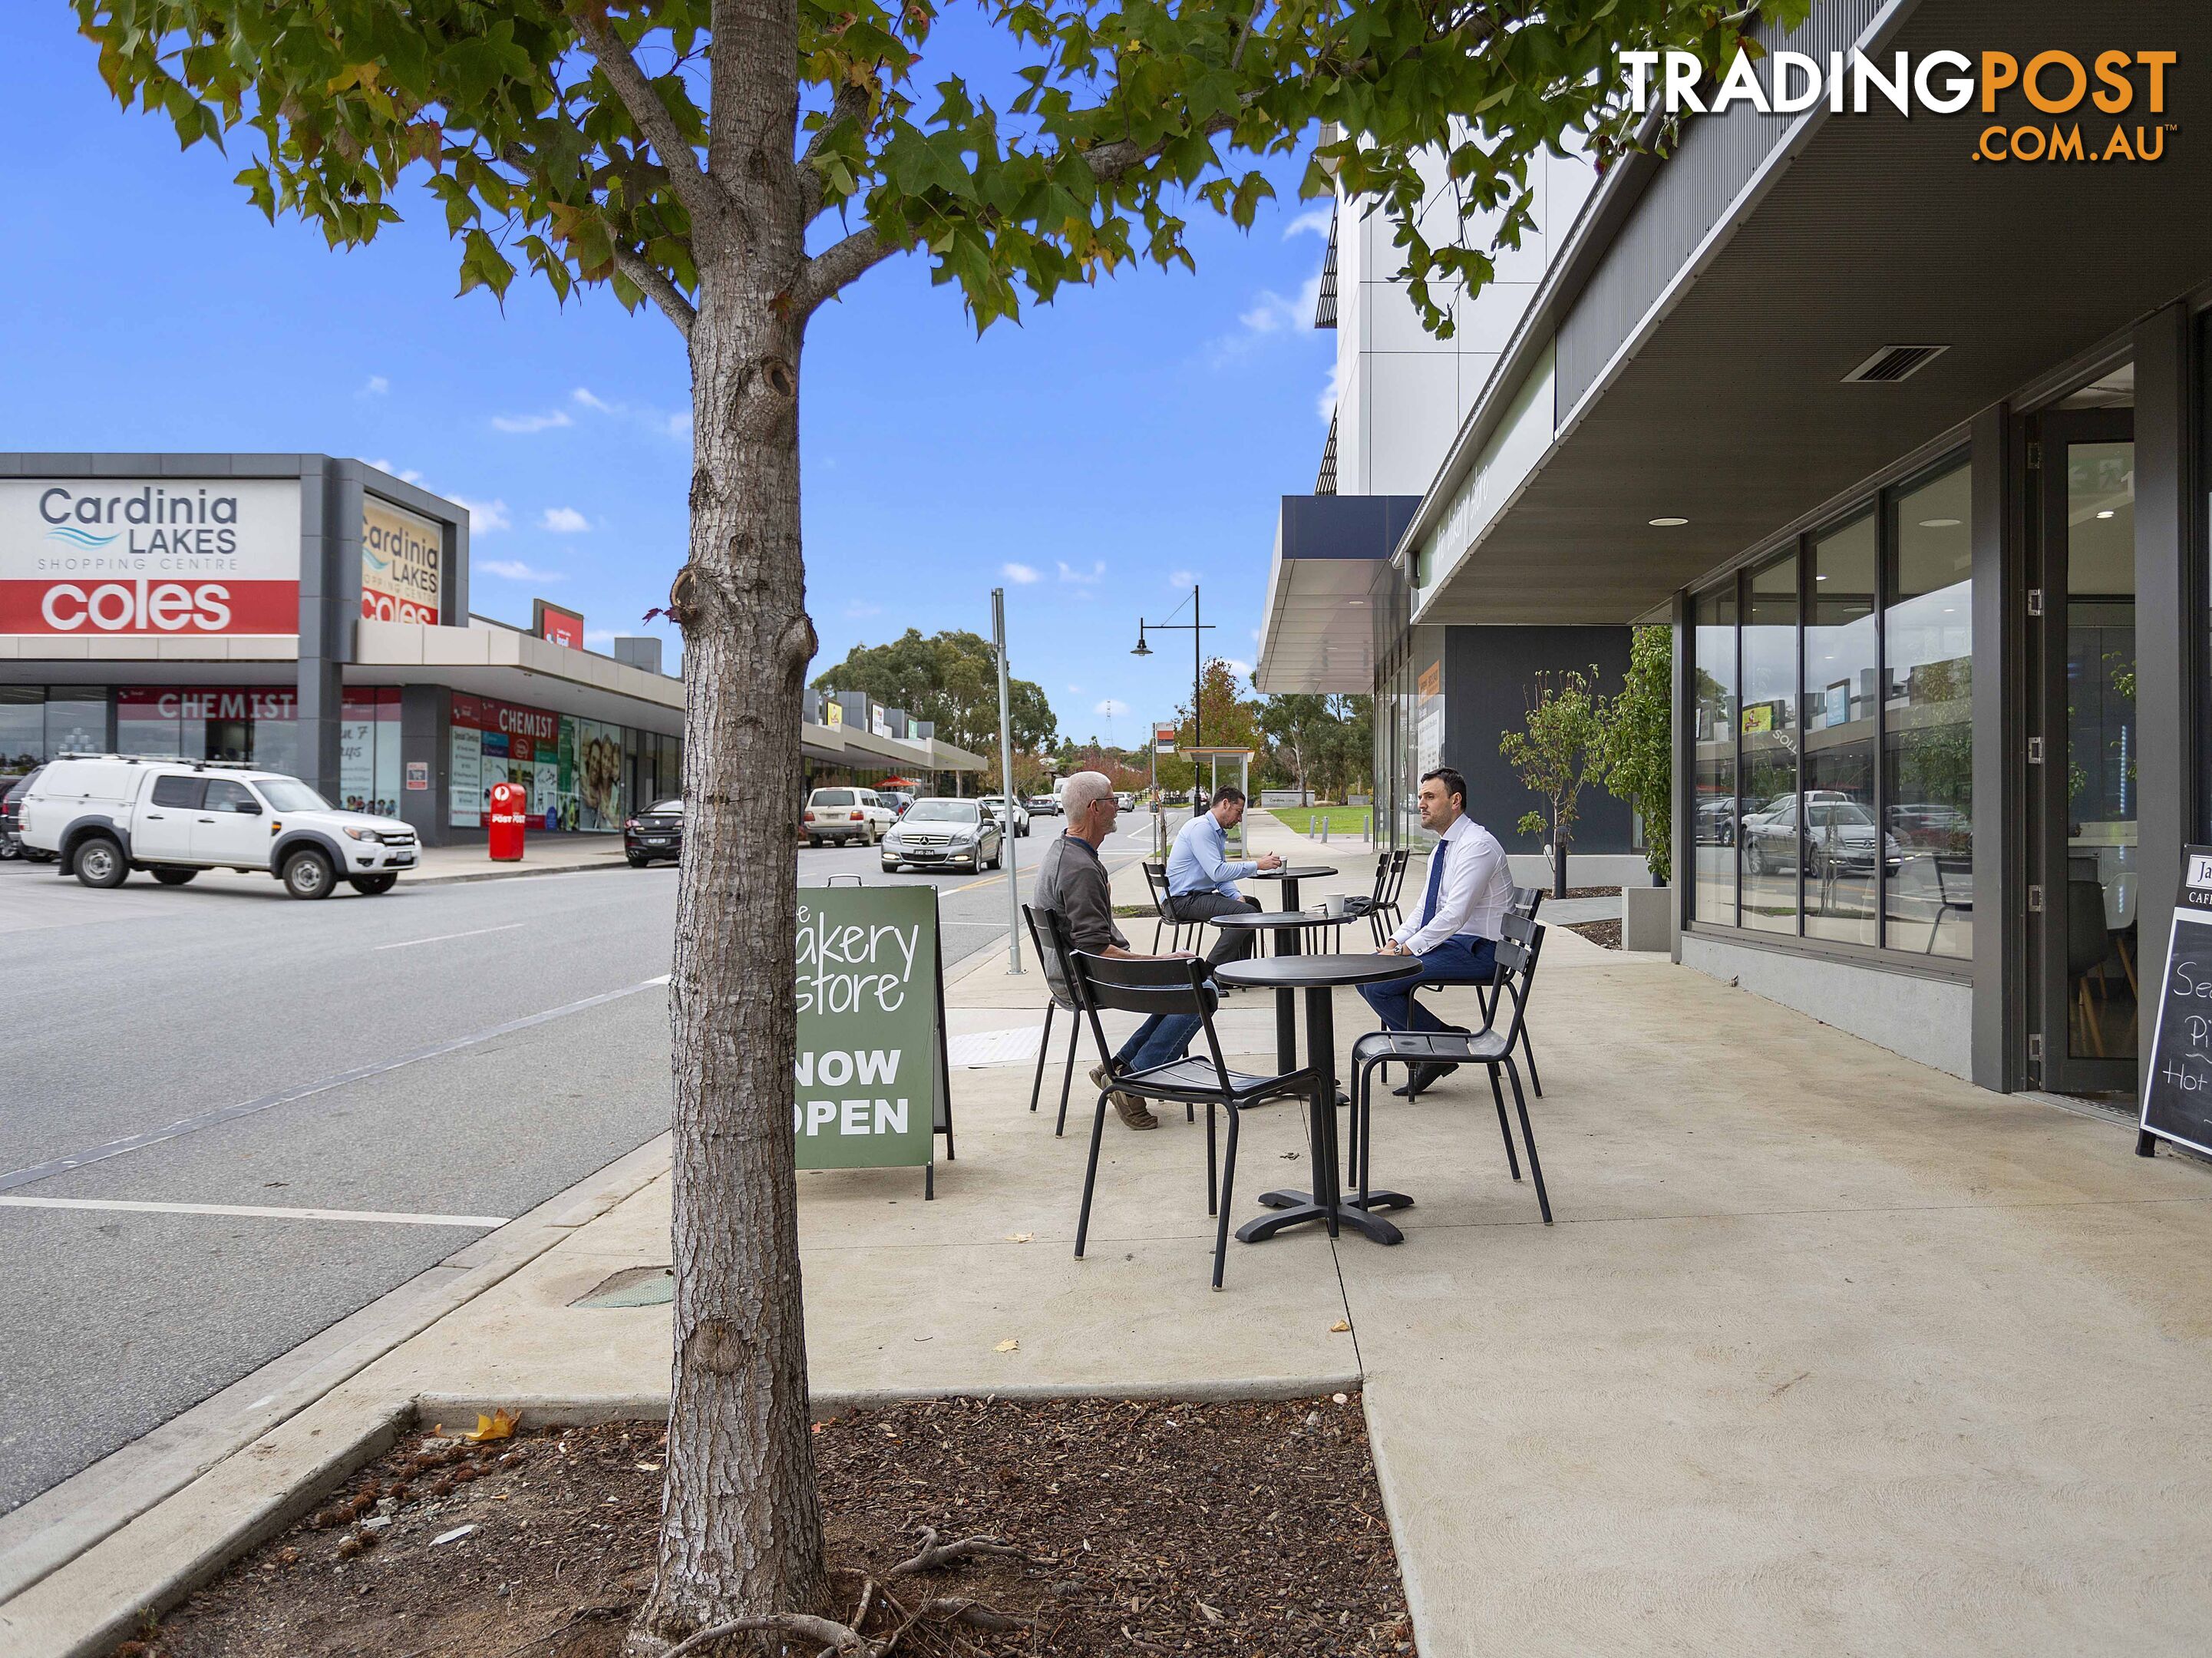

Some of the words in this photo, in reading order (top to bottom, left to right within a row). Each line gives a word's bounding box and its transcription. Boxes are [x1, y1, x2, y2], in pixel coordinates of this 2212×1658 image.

[39, 487, 237, 524] Cardinia
[129, 529, 236, 554] LAKES
[38, 558, 145, 570] SHOPPING
[160, 558, 238, 570] CENTRE
[392, 560, 437, 593] LAKES
[41, 577, 230, 630] coles
[158, 693, 293, 718] CHEMIST
[499, 708, 553, 739] CHEMIST
[796, 911, 919, 983] akery
[2162, 1059, 2207, 1091] Hot
